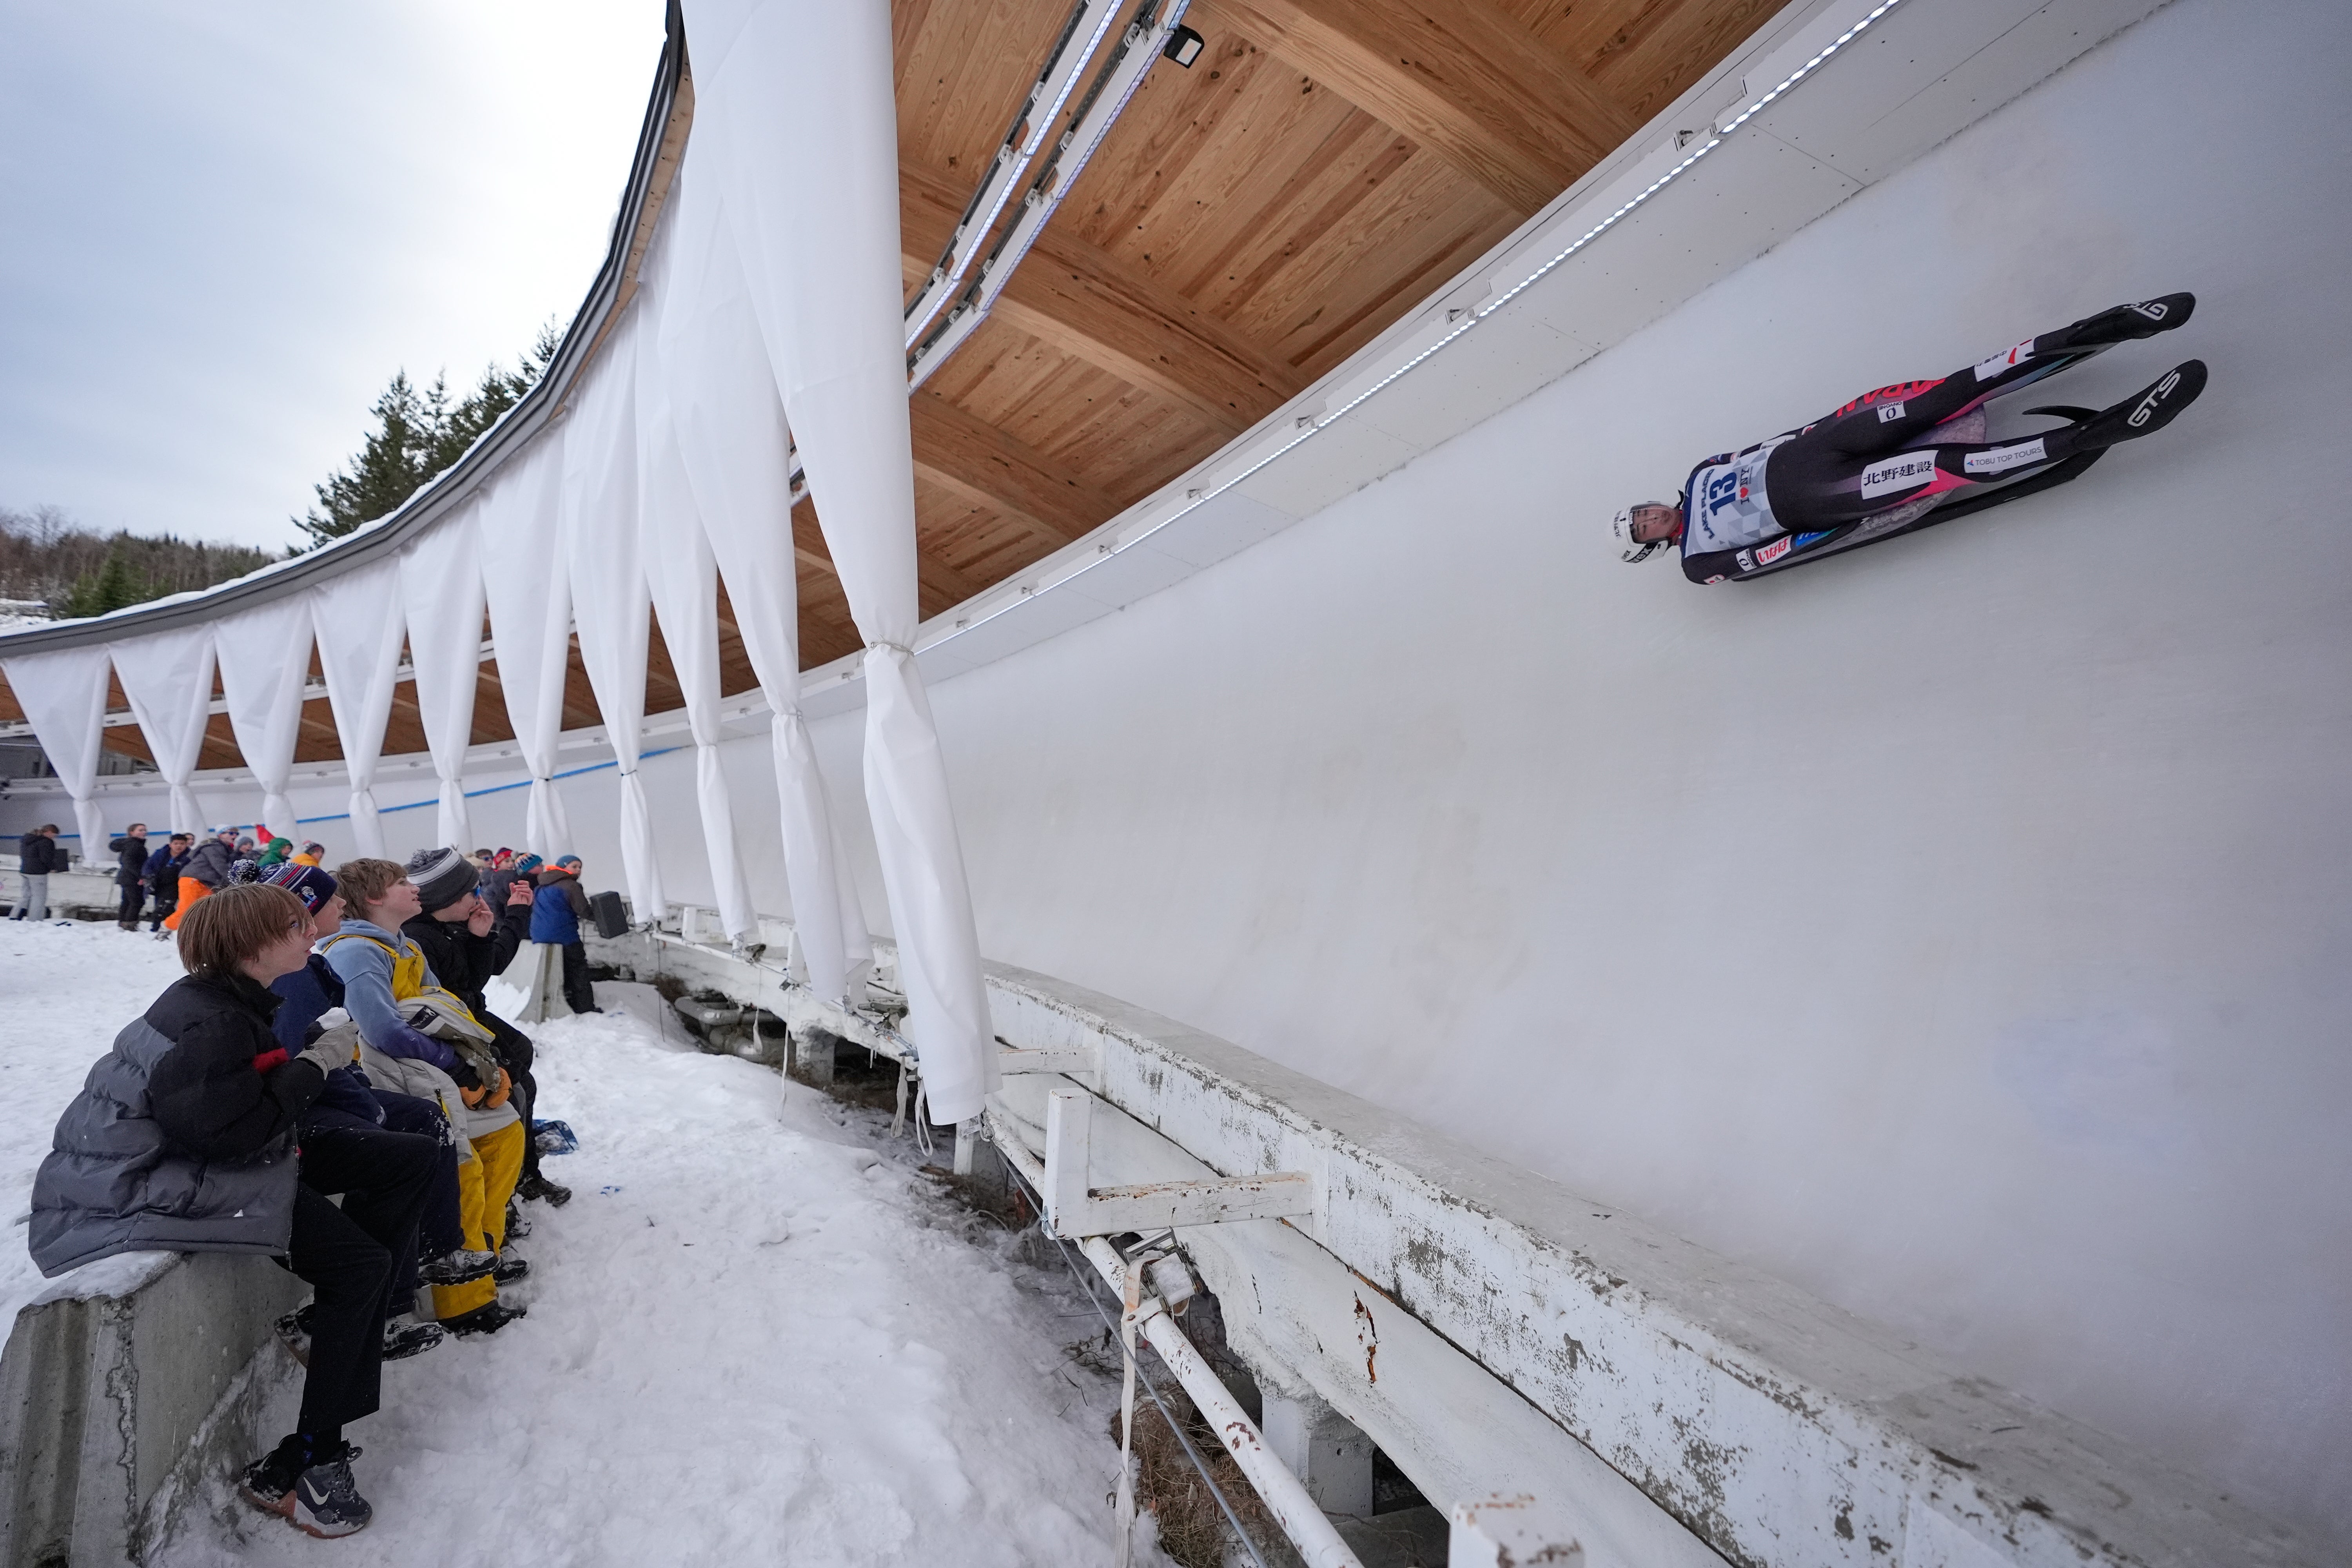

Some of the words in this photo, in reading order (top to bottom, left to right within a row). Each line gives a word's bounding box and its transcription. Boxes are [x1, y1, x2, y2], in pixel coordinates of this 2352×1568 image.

[2127, 370, 2181, 426] GTS
[1975, 457, 1995, 466] TOBU
[1997, 454, 2012, 462] TOP
[2014, 446, 2042, 459] TOURS
[1701, 468, 1715, 508] PLACID
[1740, 468, 1749, 487] NY
[1864, 461, 1933, 486] 北野建設
[1710, 472, 1737, 516] 13
[1702, 510, 1715, 540] LAKE
